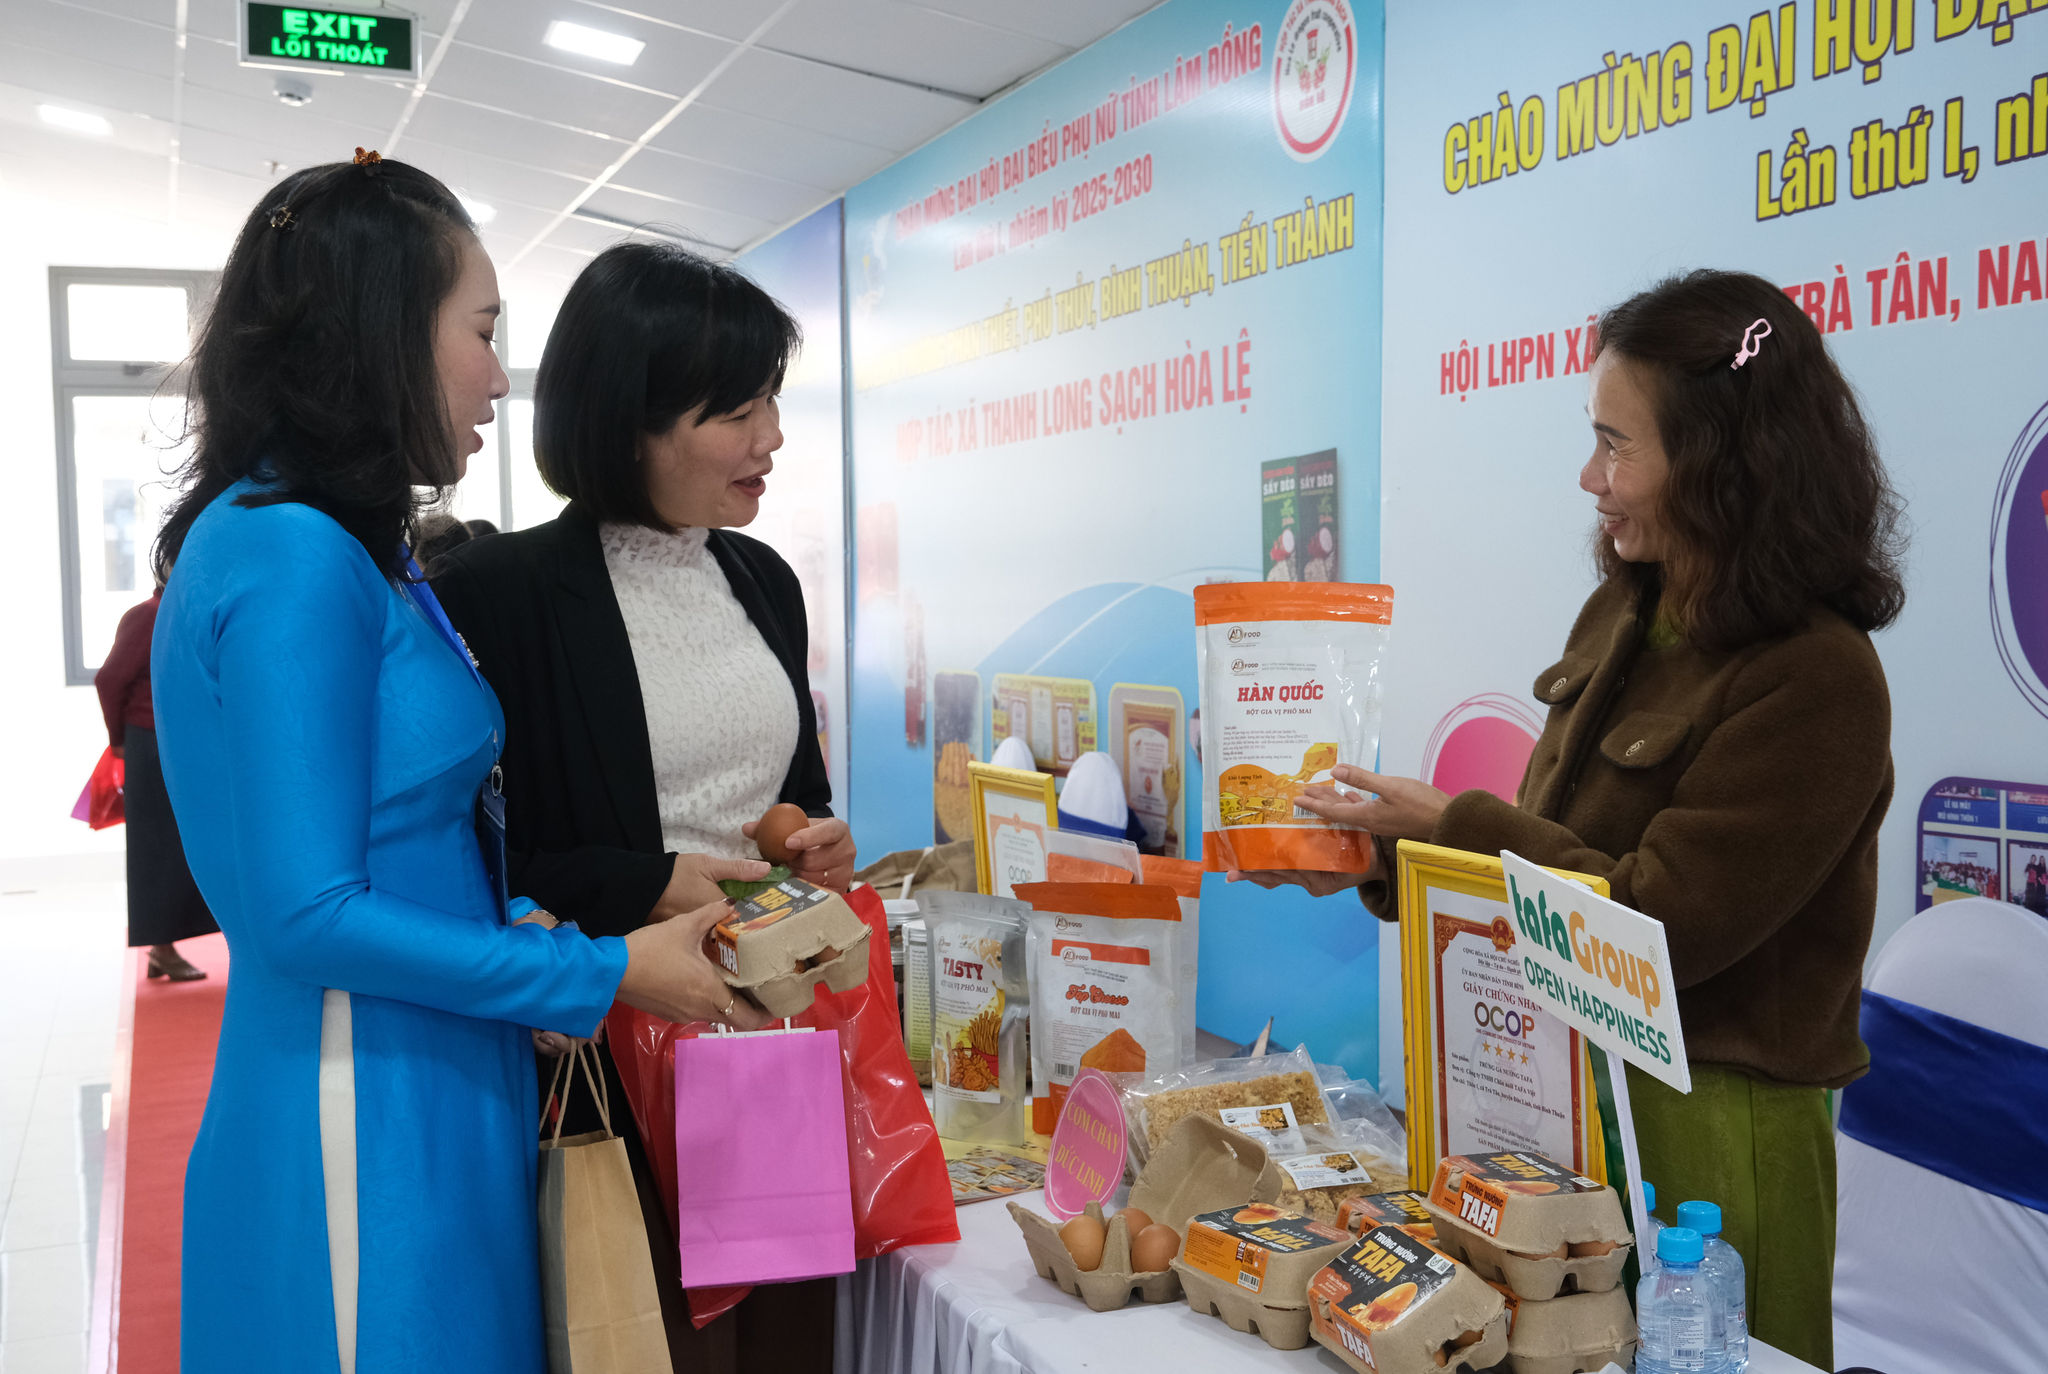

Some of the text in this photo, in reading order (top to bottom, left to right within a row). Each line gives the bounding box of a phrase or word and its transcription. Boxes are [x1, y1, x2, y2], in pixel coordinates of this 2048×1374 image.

[282, 9, 377, 41] EXIT
[315, 42, 388, 66] THOÁT
[1003, 148, 1024, 194] ĐẠI
[1027, 120, 1058, 179] BIỂU
[1062, 112, 1090, 162] PHỤ
[1096, 92, 1119, 145] NỮ
[1121, 76, 1159, 132] TỈNH
[1164, 50, 1203, 112] LÂM
[1207, 21, 1261, 88] ĐỒNG
[1443, 91, 1545, 195] CHÀO
[1555, 41, 1692, 161] MỪNG
[1705, 1, 1797, 119] ĐẠI
[1756, 128, 1836, 222] Lần
[1850, 104, 1933, 200] thứ
[1009, 204, 1048, 249] nhiệm
[1071, 153, 1153, 223] 2025-2030
[1100, 264, 1142, 322] BÌNH
[1146, 238, 1215, 308] THUẬN,
[1219, 210, 1268, 286] TIẾN
[1272, 192, 1354, 269] THÀNH
[1440, 338, 1479, 403] HỘI
[1488, 332, 1555, 388] LHPN
[1866, 250, 1961, 327] TÂN,
[1977, 237, 2048, 310] NA
[982, 391, 1037, 449] THANH
[1043, 377, 1092, 437] LONG
[1099, 362, 1157, 436] SẠCH
[1165, 339, 1214, 415] HÒA
[1222, 327, 1252, 414] LỆ
[1237, 679, 1324, 703] HÀN QUỐC
[1283, 707, 1297, 715] PHÔ
[718, 941, 738, 975] TAFA
[1509, 873, 1661, 1017] tafaGroup
[943, 957, 983, 980] TASTY
[1463, 981, 1516, 1005] GIẤY CHỨNG
[1524, 956, 1672, 1065] OPEN HAPPINESS
[1474, 1001, 1535, 1040] OCOP
[1075, 1161, 1106, 1197] LINH
[1465, 1180, 1484, 1197] TRỨNG
[1460, 1191, 1498, 1236] TAFA
[1353, 1239, 1406, 1283] TAFA
[1373, 1231, 1418, 1264] TRỨNG NƯỚNG
[1335, 1322, 1376, 1370] TAFA
